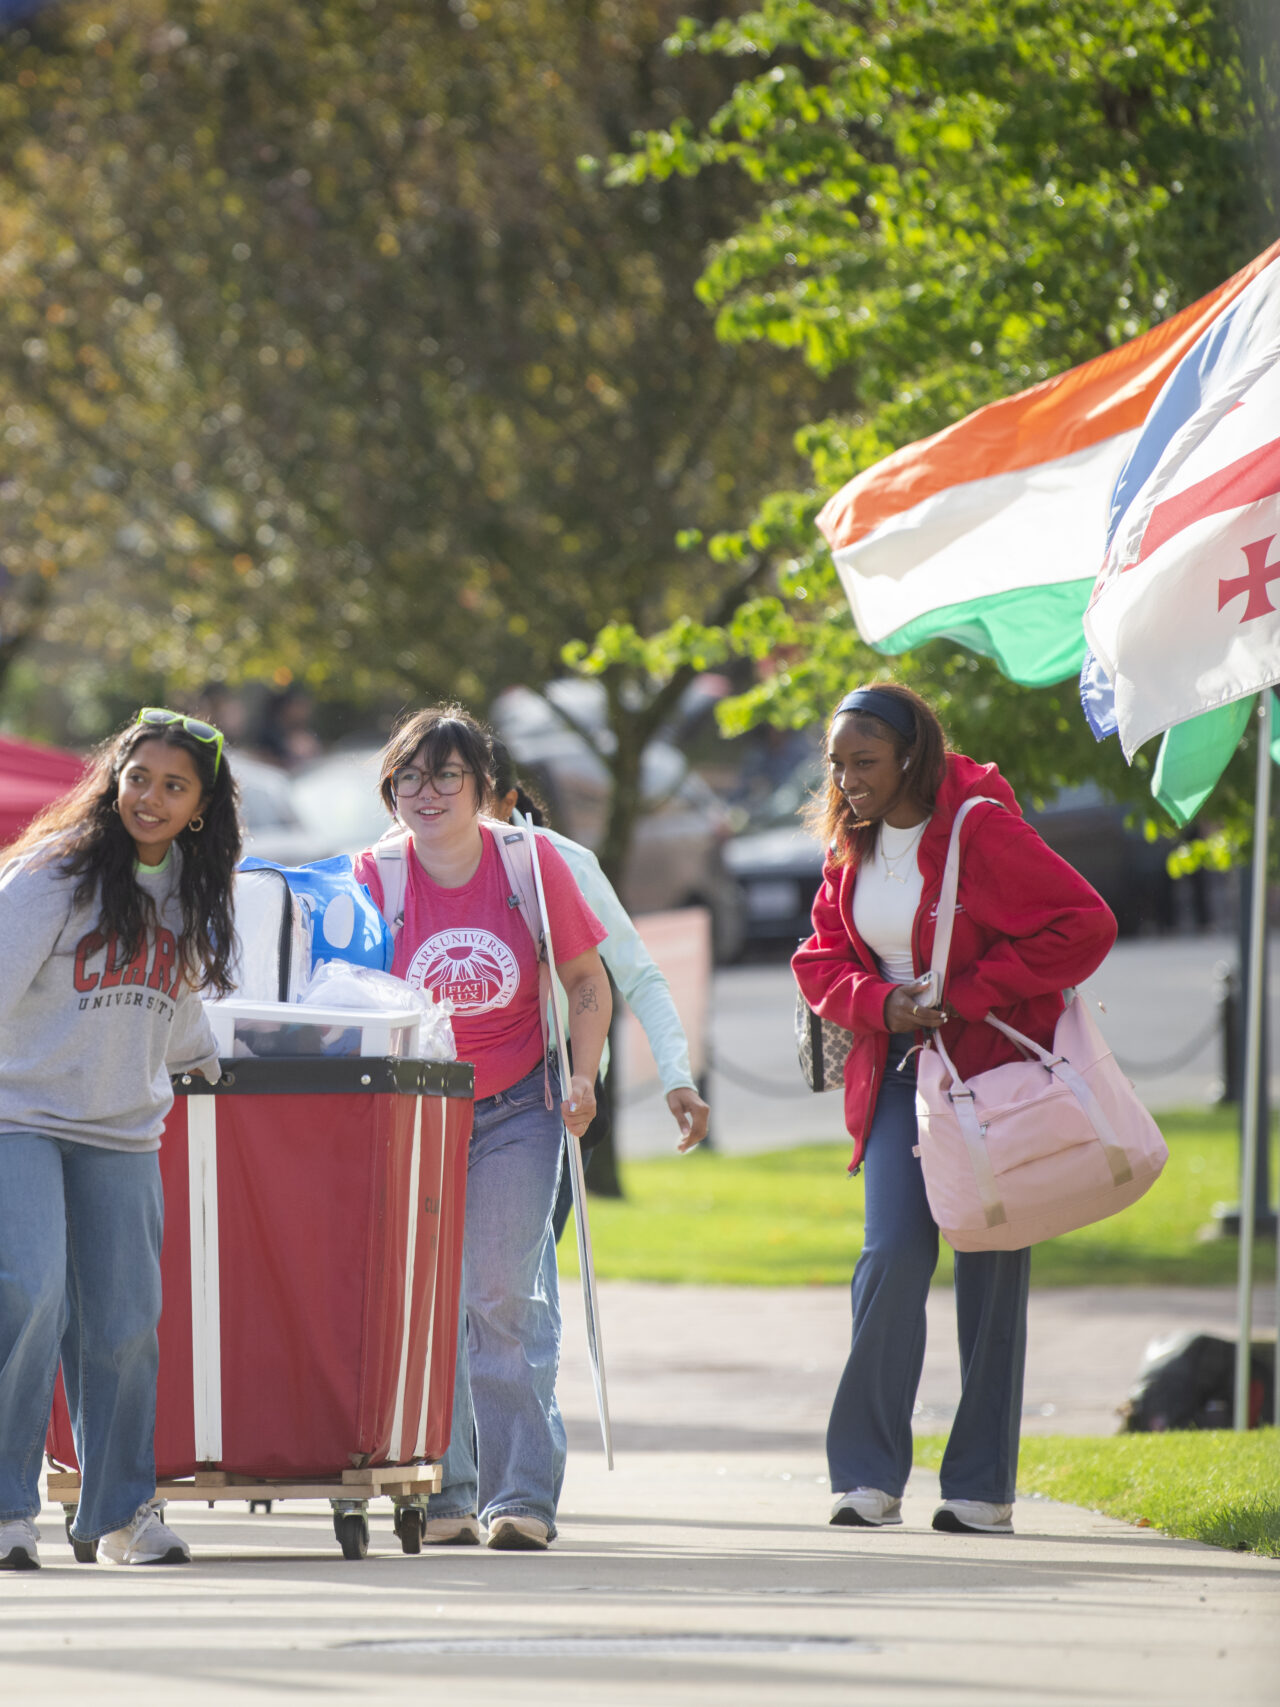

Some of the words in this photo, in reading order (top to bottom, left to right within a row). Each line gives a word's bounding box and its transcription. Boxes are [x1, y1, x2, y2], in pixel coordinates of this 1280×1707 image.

[410, 941, 439, 991] CLARK
[439, 933, 516, 979] UNIVERSITY
[448, 982, 481, 994] FIAT
[449, 991, 480, 1001] LUX
